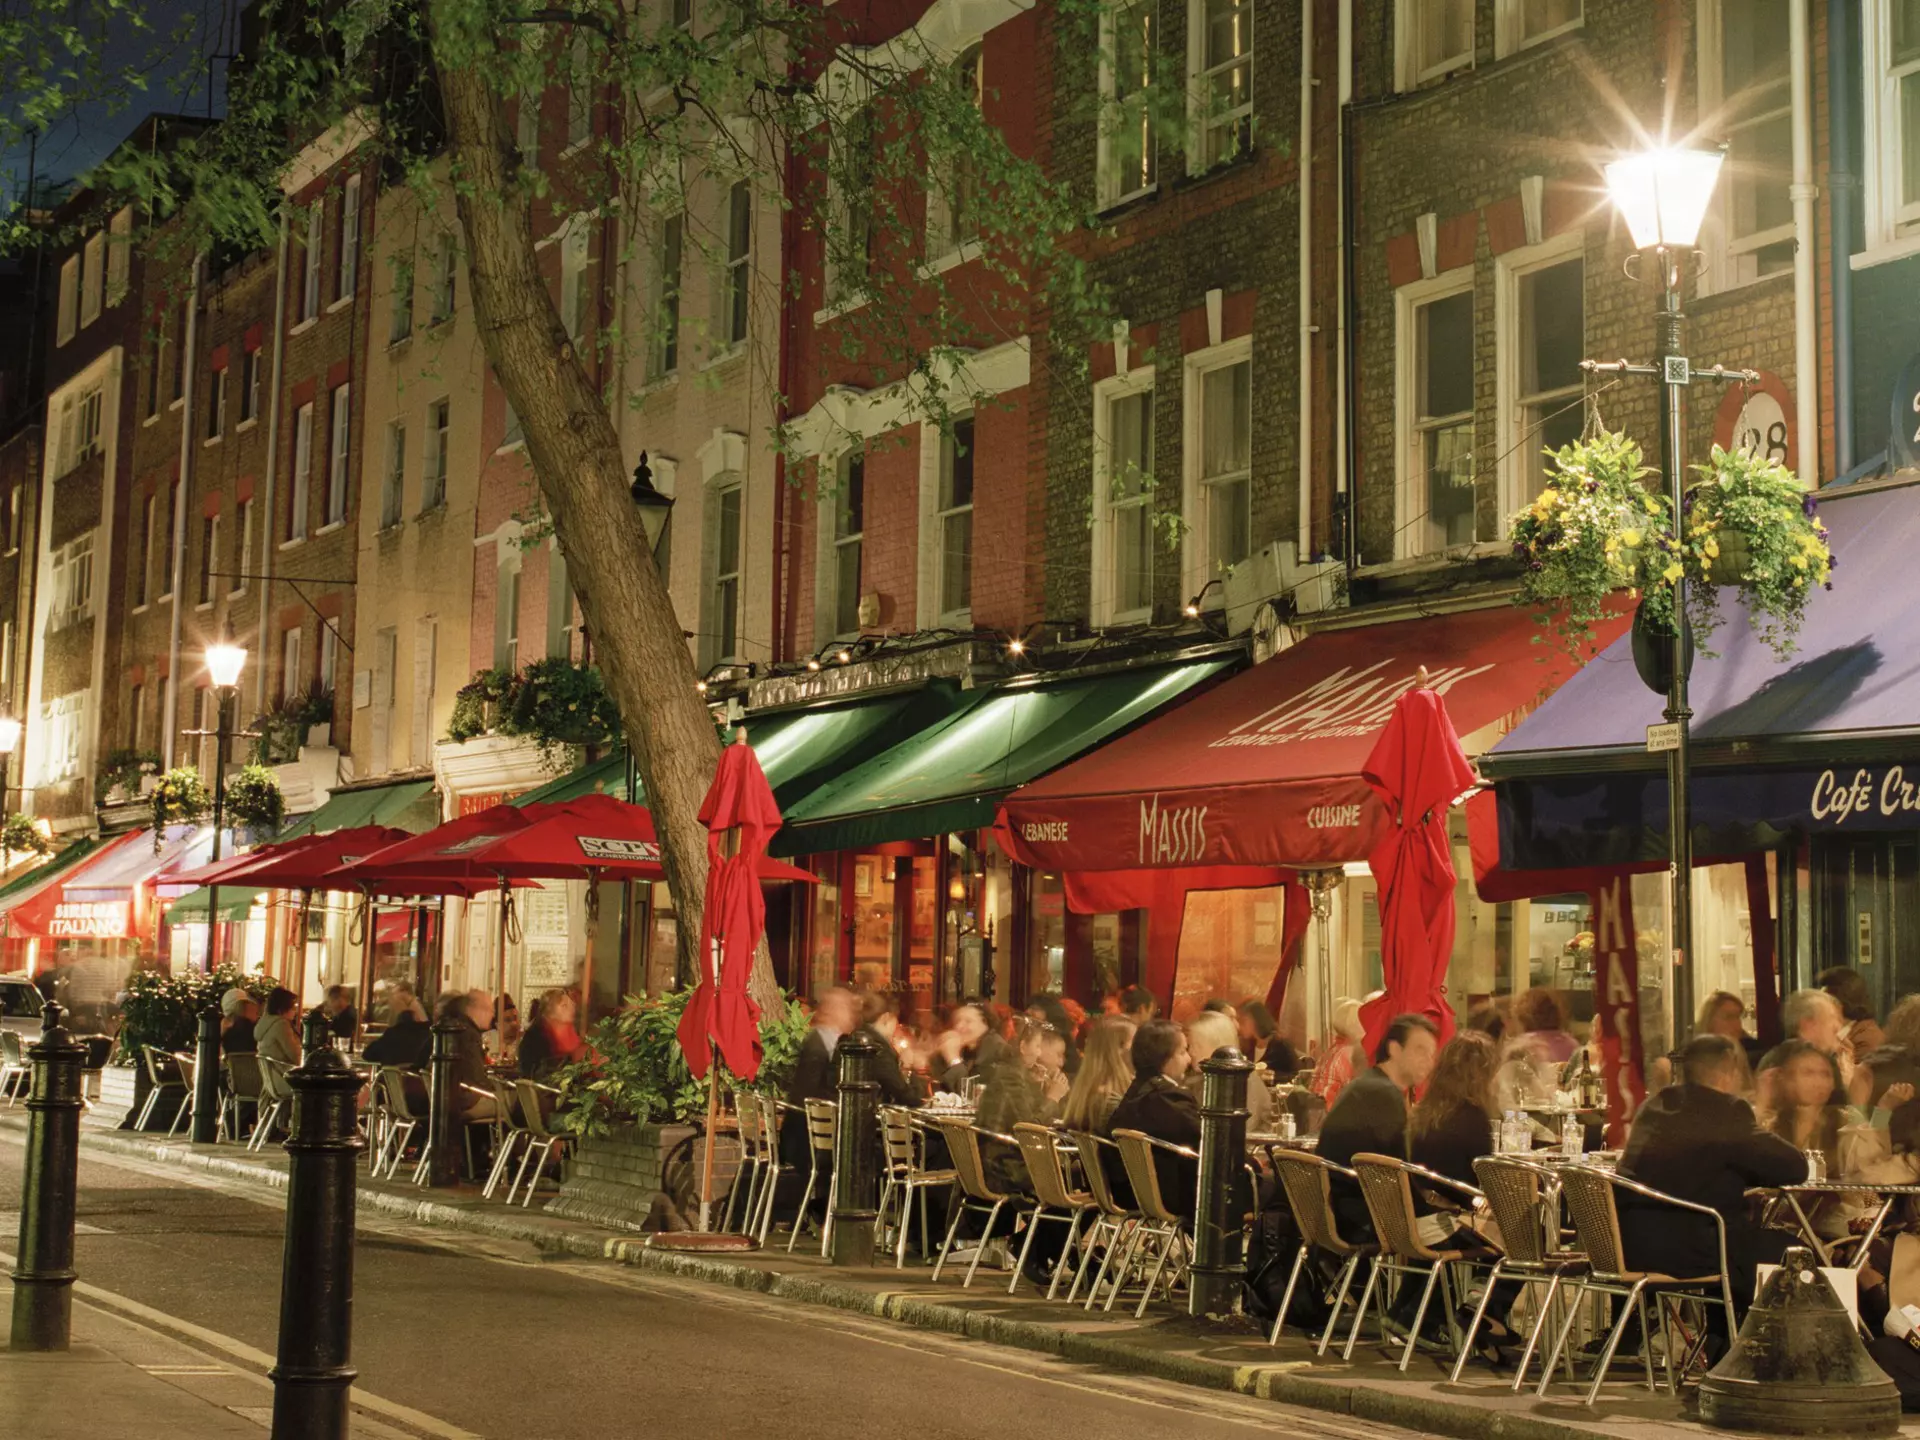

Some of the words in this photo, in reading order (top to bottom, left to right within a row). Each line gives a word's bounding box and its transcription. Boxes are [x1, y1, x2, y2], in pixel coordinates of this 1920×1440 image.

[1811, 768, 1872, 824] Café
[1307, 804, 1362, 828] CUISINE
[48, 918, 125, 936] ITALIANO
